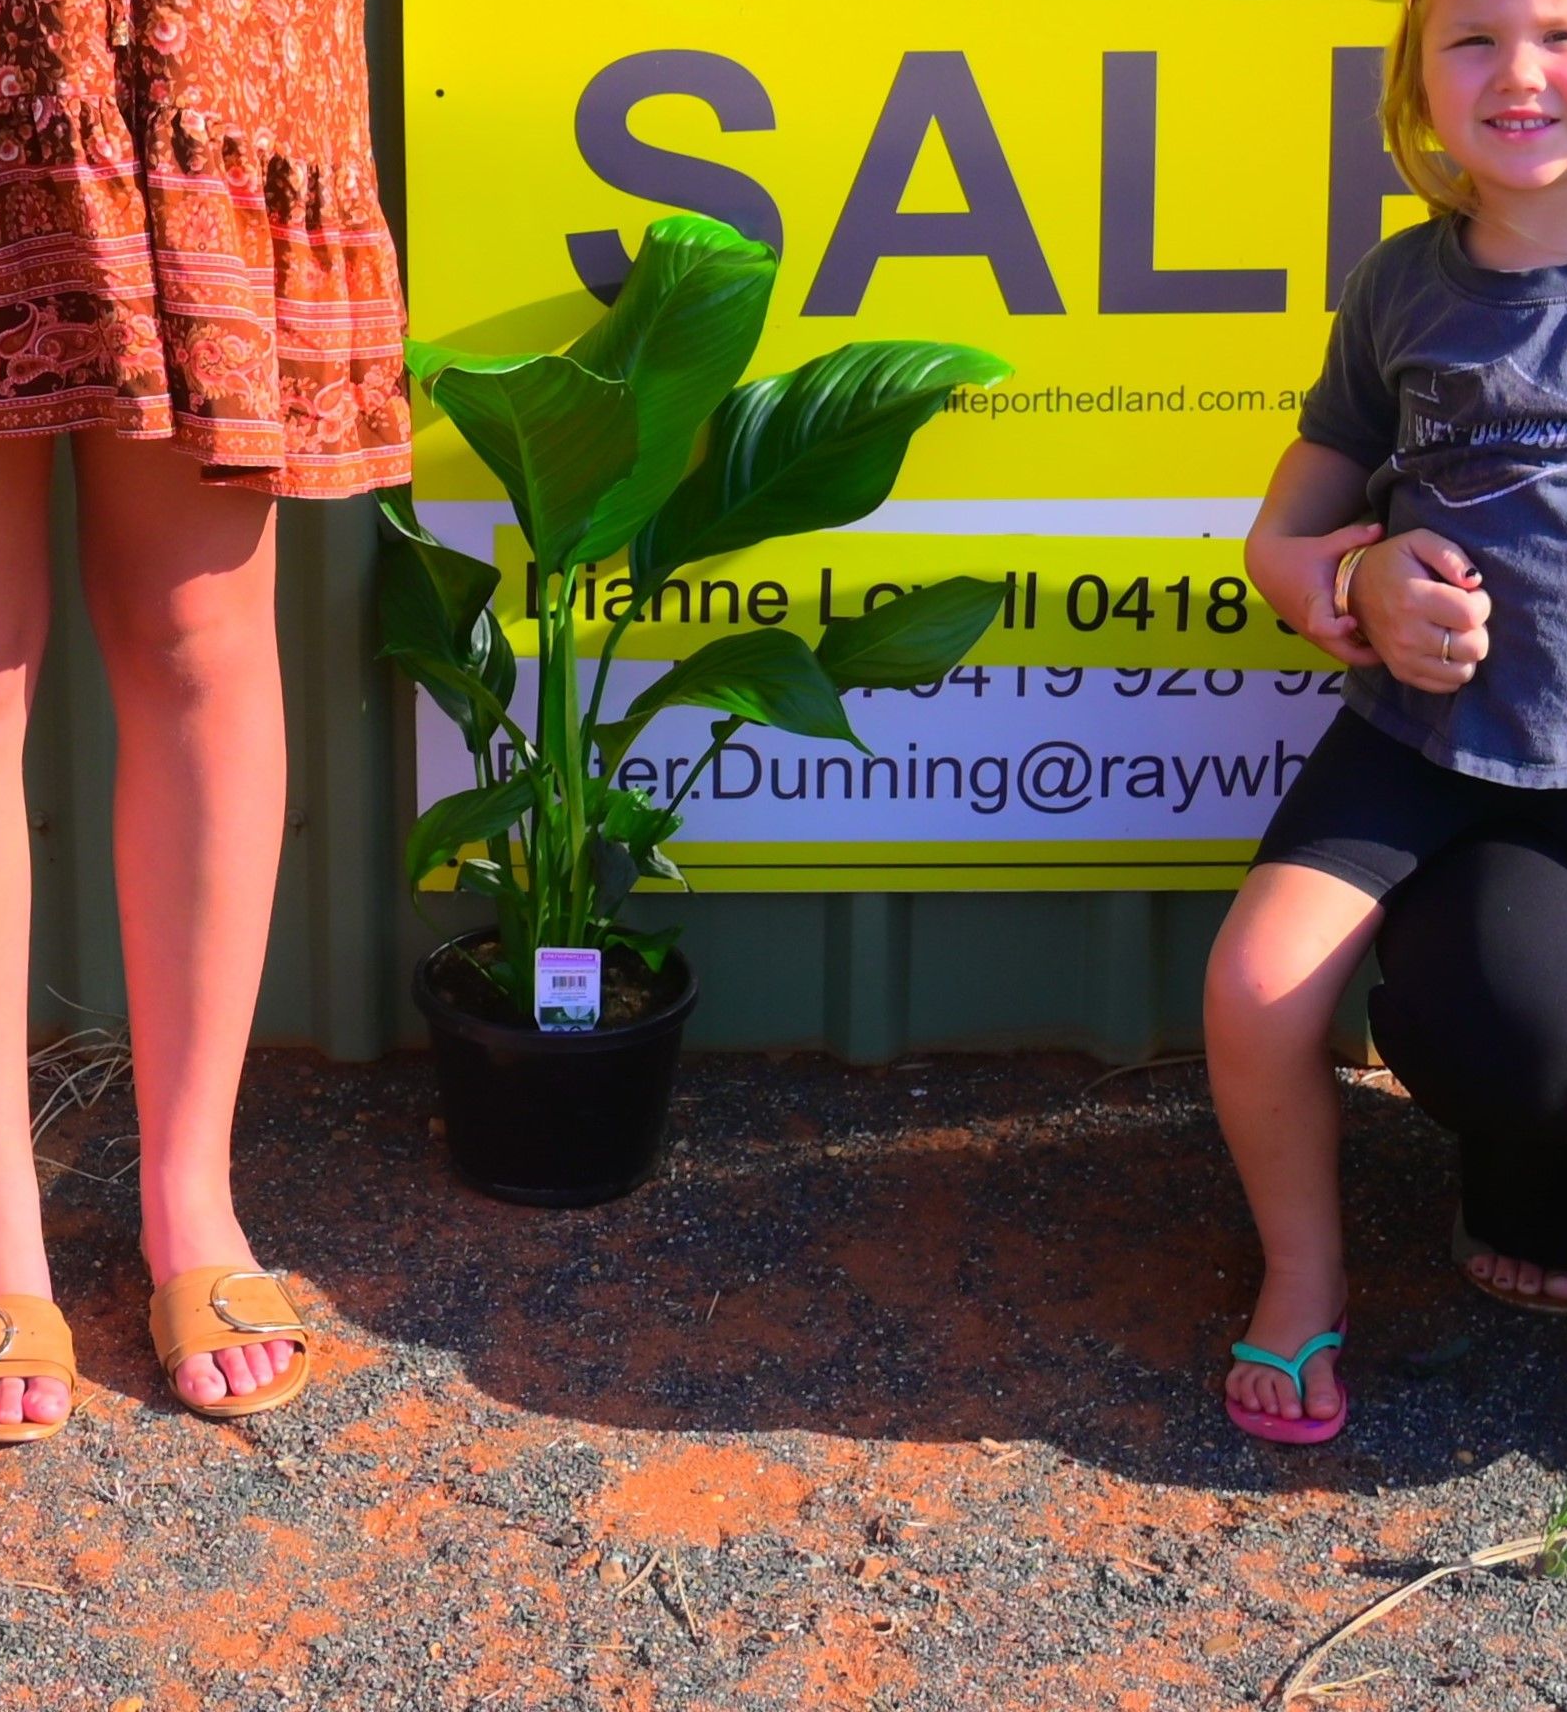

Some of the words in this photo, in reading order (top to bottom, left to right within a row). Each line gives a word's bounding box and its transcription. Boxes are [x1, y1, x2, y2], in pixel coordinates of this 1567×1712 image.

[942, 385, 1306, 421] iteporthedland.com.a
[525, 561, 789, 625] Dianne
[819, 567, 1037, 629] Loll
[1066, 573, 1249, 634] 0418
[498, 740, 1306, 814] ter.Dunning@raywh
